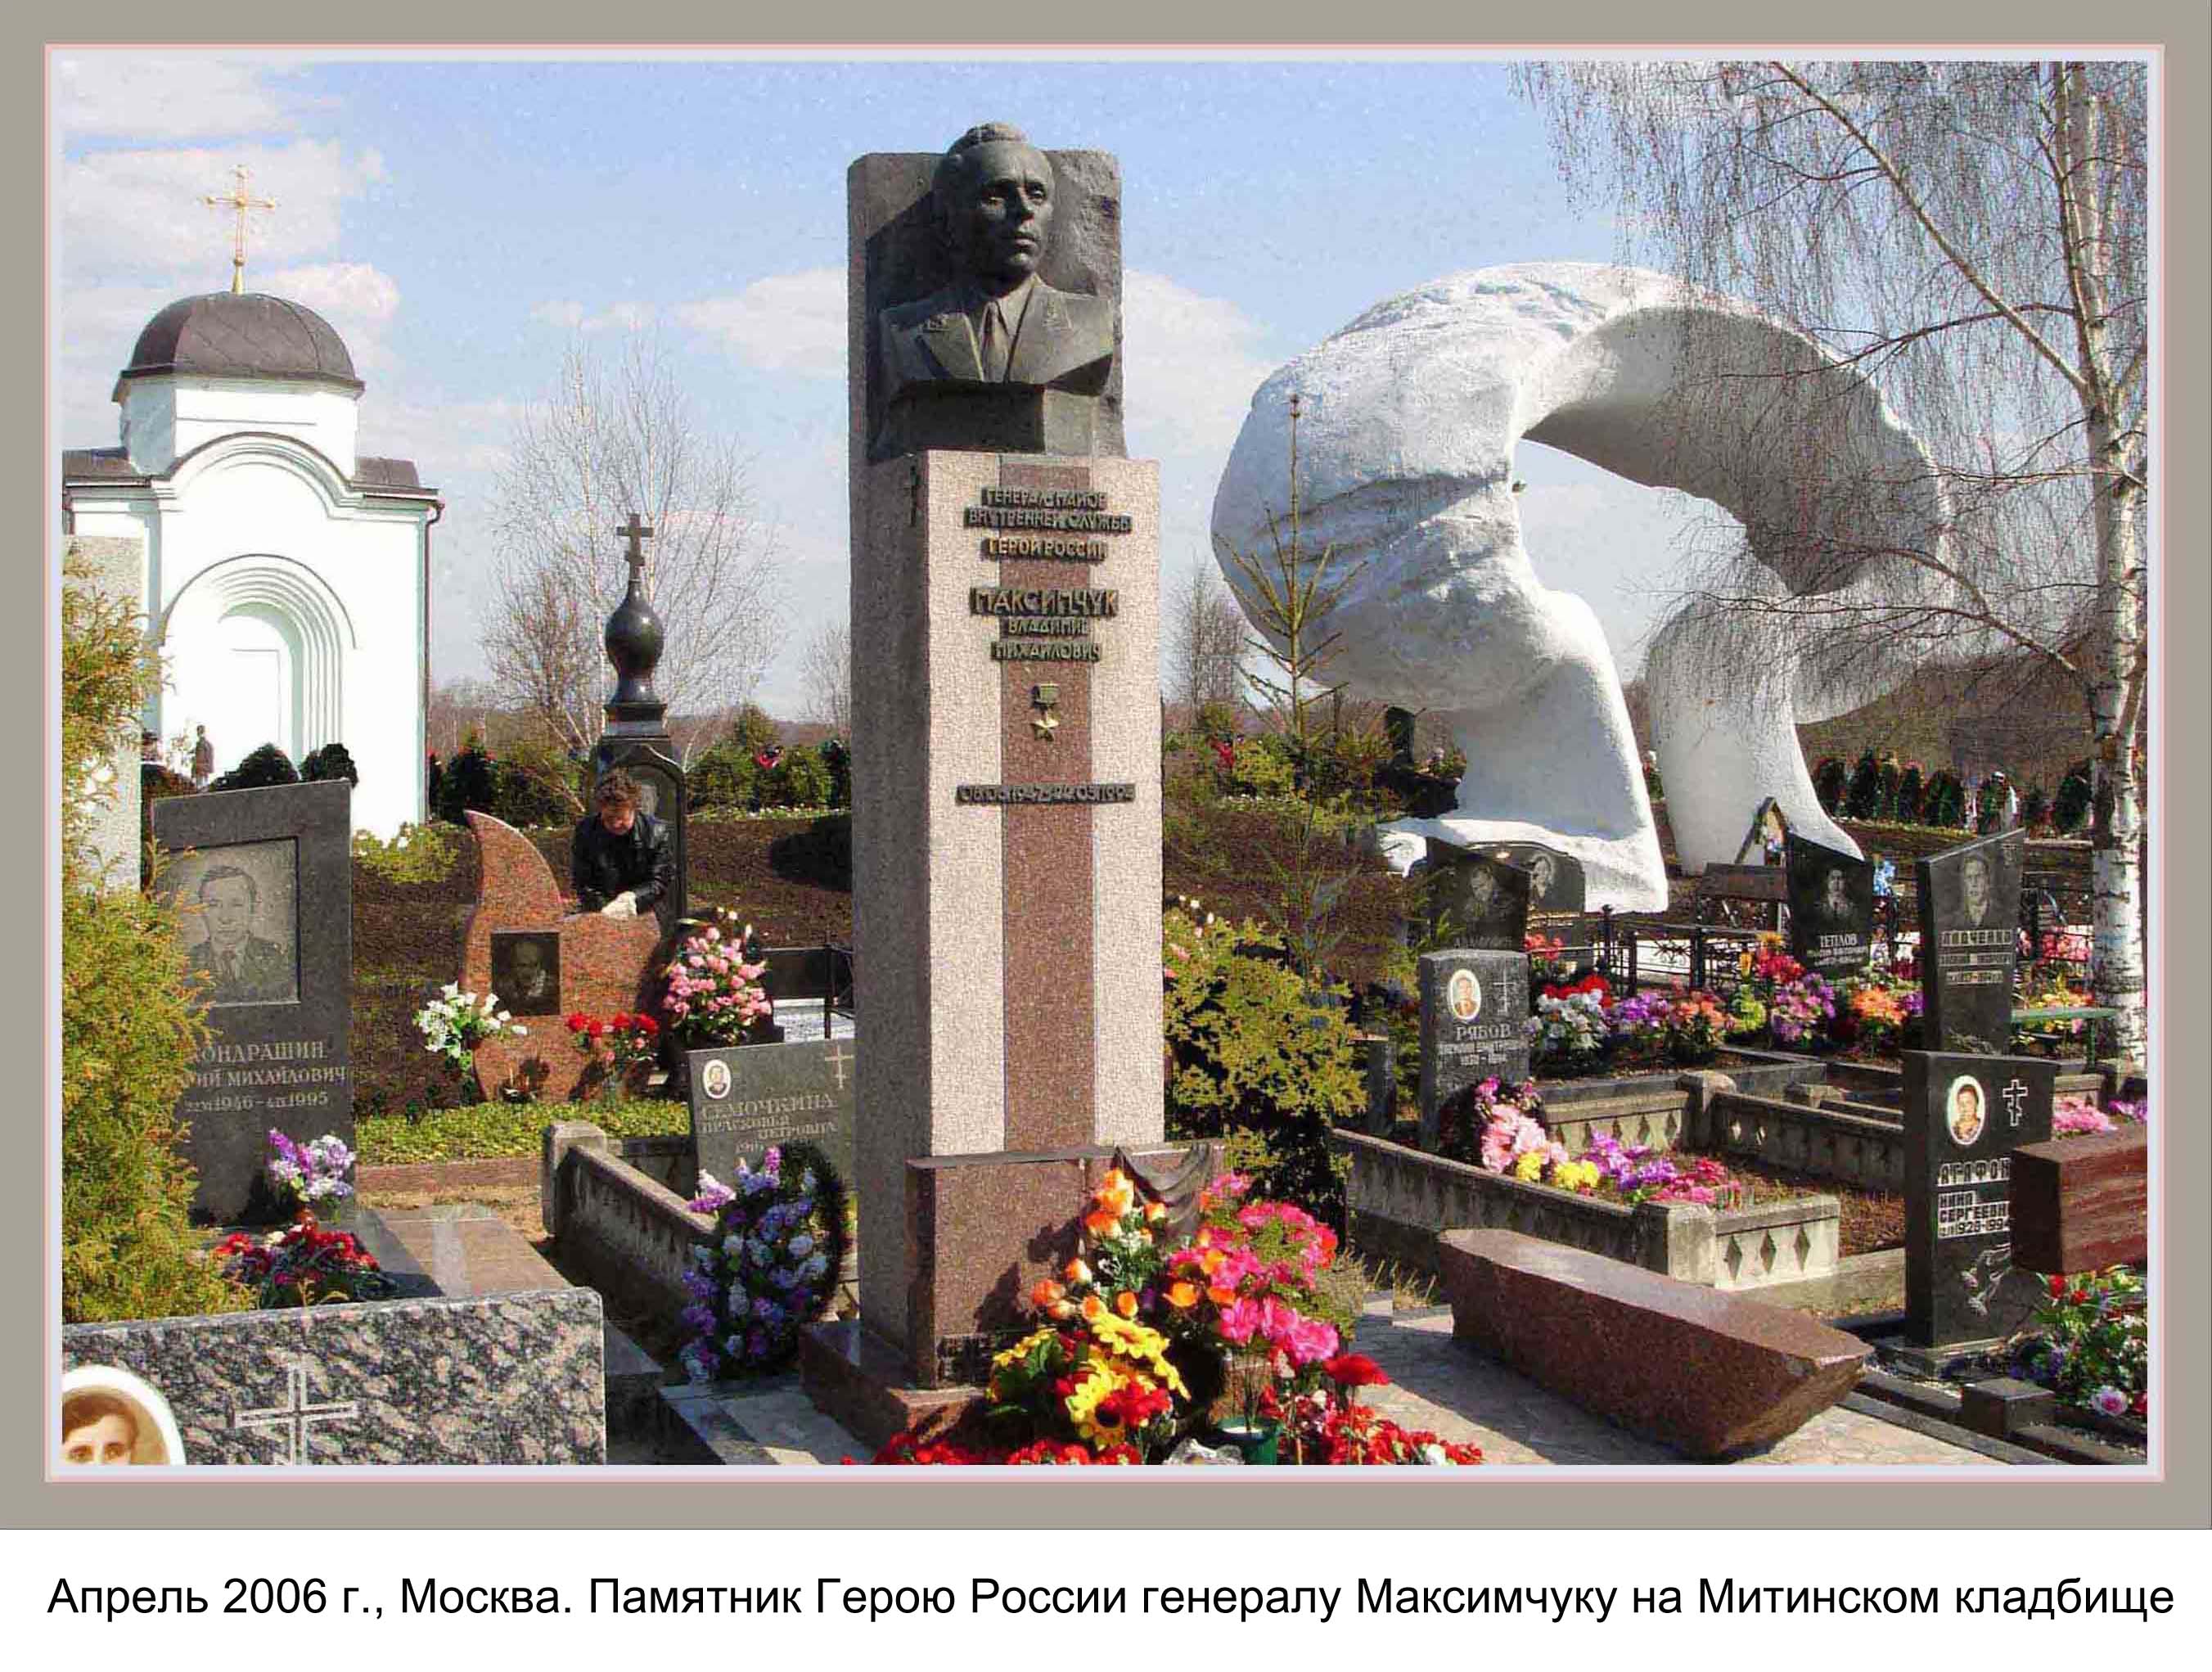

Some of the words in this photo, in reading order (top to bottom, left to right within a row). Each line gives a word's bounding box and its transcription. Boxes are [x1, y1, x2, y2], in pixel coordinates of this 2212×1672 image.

[971, 588, 1119, 616] МАКСИМЧУК
[1456, 1023, 1511, 1041] РЯБОВ
[228, 1066, 347, 1087] МИХАЙЛОВИЧ
[1938, 1157, 2011, 1187] АГАФОН
[1938, 1201, 2011, 1226] СЕРГЕЕВН
